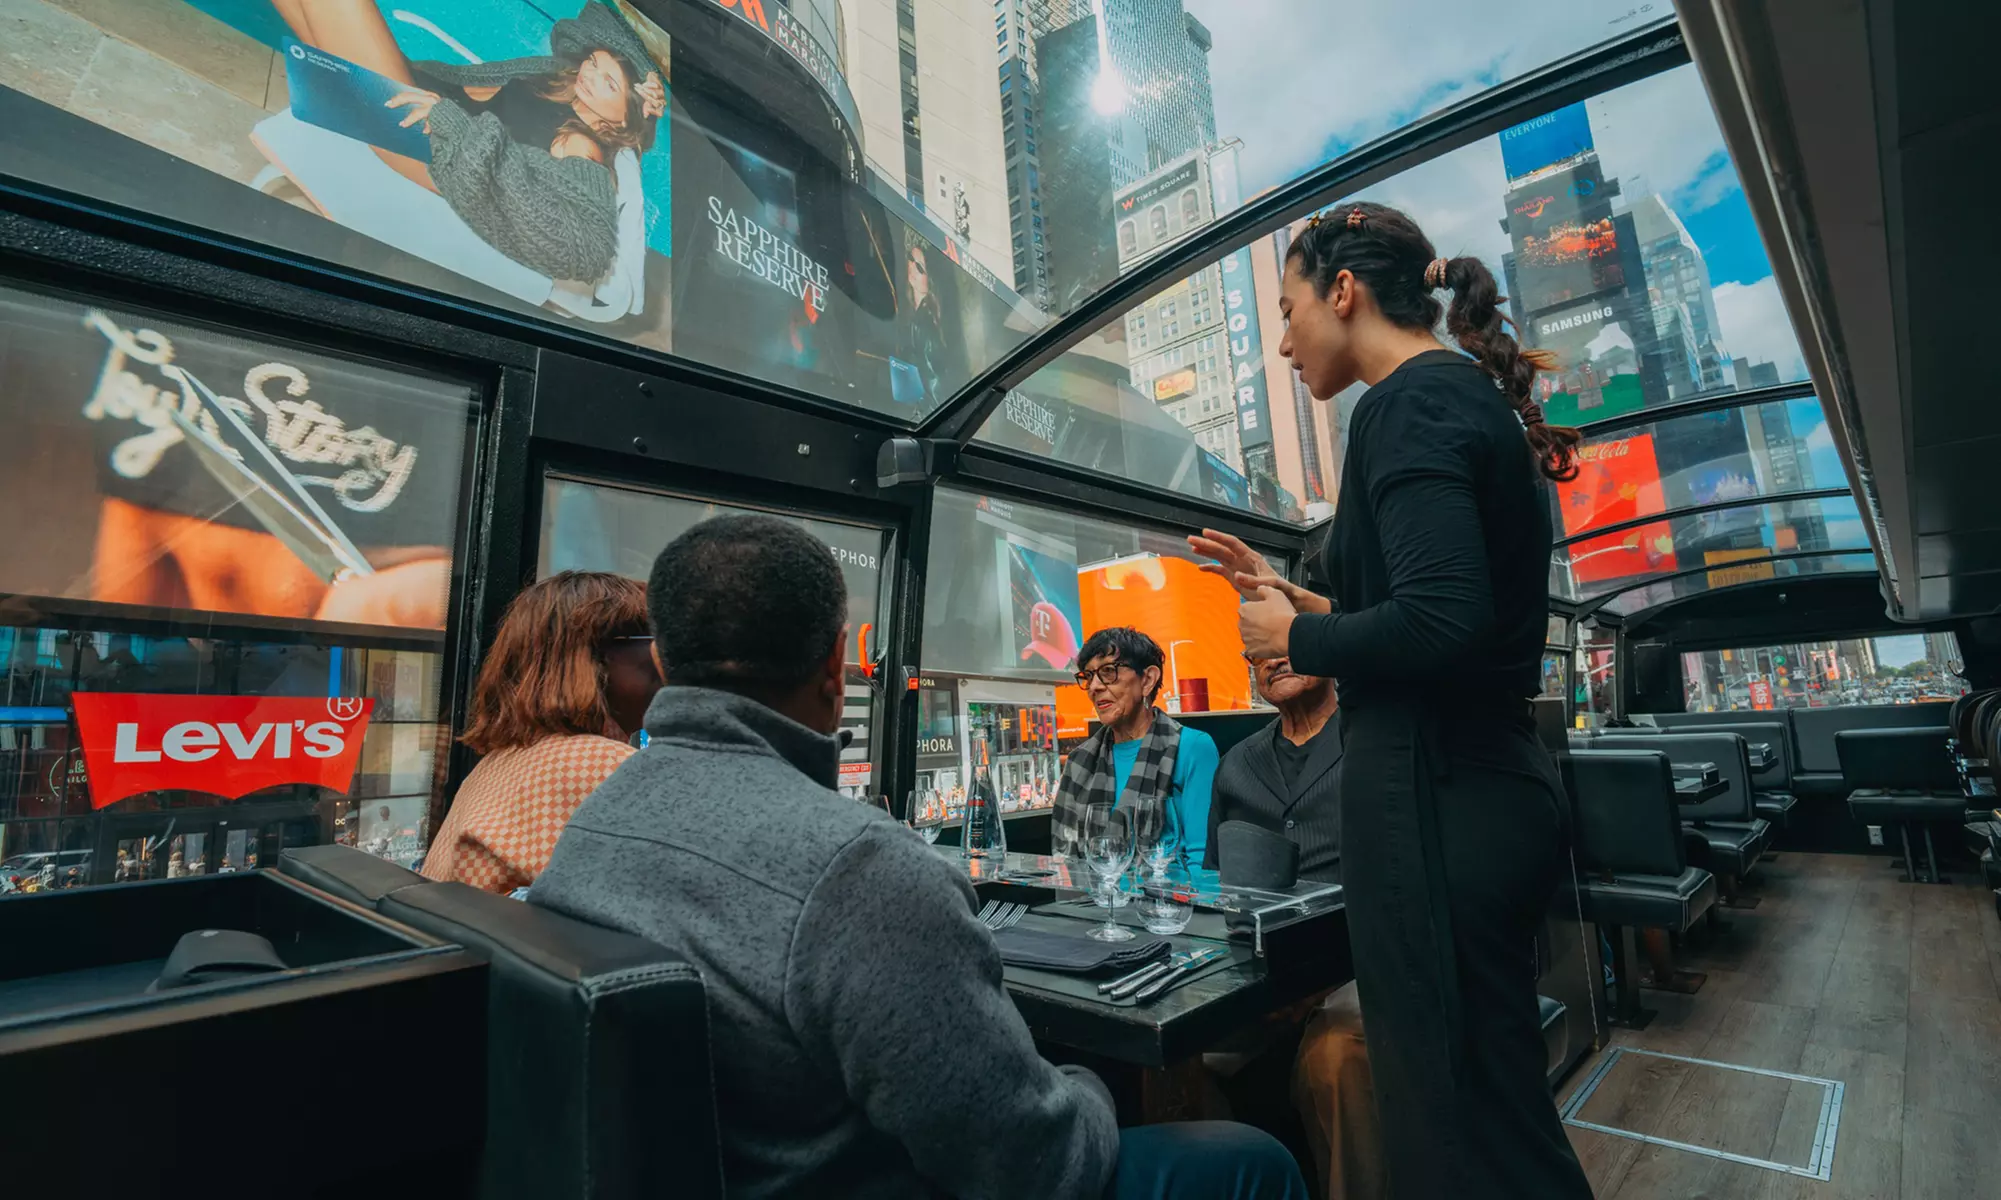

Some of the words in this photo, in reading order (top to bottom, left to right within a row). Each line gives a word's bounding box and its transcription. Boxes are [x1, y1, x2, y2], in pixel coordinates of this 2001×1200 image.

[778, 8, 841, 87] MARRIOTT
[778, 27, 837, 96] MARQUIS
[1505, 113, 1557, 140] EVERYONE
[1136, 189, 1159, 204] TIMES
[1160, 170, 1191, 192] SQUARE
[707, 195, 830, 291] SAPPHIRE
[715, 225, 825, 312] RESERVE
[1541, 306, 1613, 335] SAMSUNG
[1227, 289, 1258, 431] SQUARE
[1005, 401, 1055, 446] RESERVE
[830, 546, 880, 570] EPHOR
